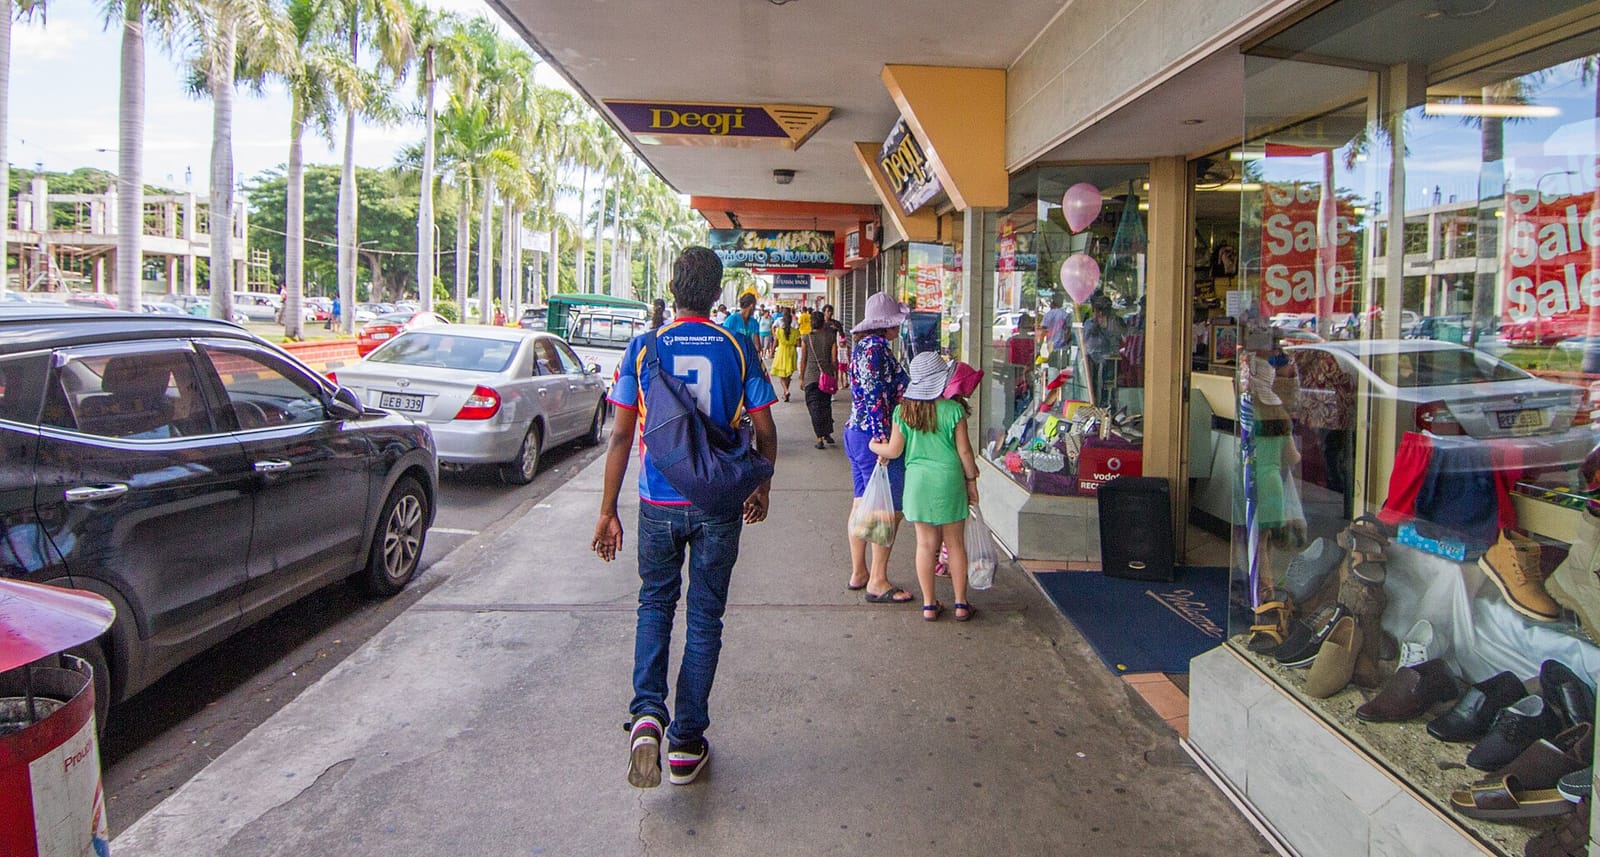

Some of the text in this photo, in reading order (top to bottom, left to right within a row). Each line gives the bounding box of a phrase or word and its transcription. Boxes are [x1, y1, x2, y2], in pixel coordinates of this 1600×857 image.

[649, 107, 745, 136] Deoji
[1266, 213, 1351, 256] Sale
[1510, 204, 1600, 268] Sale
[714, 249, 829, 264] PHOTO STUDIO
[1265, 259, 1349, 306] Sale
[1507, 263, 1600, 322] Sale
[389, 396, 421, 409] EB 339
